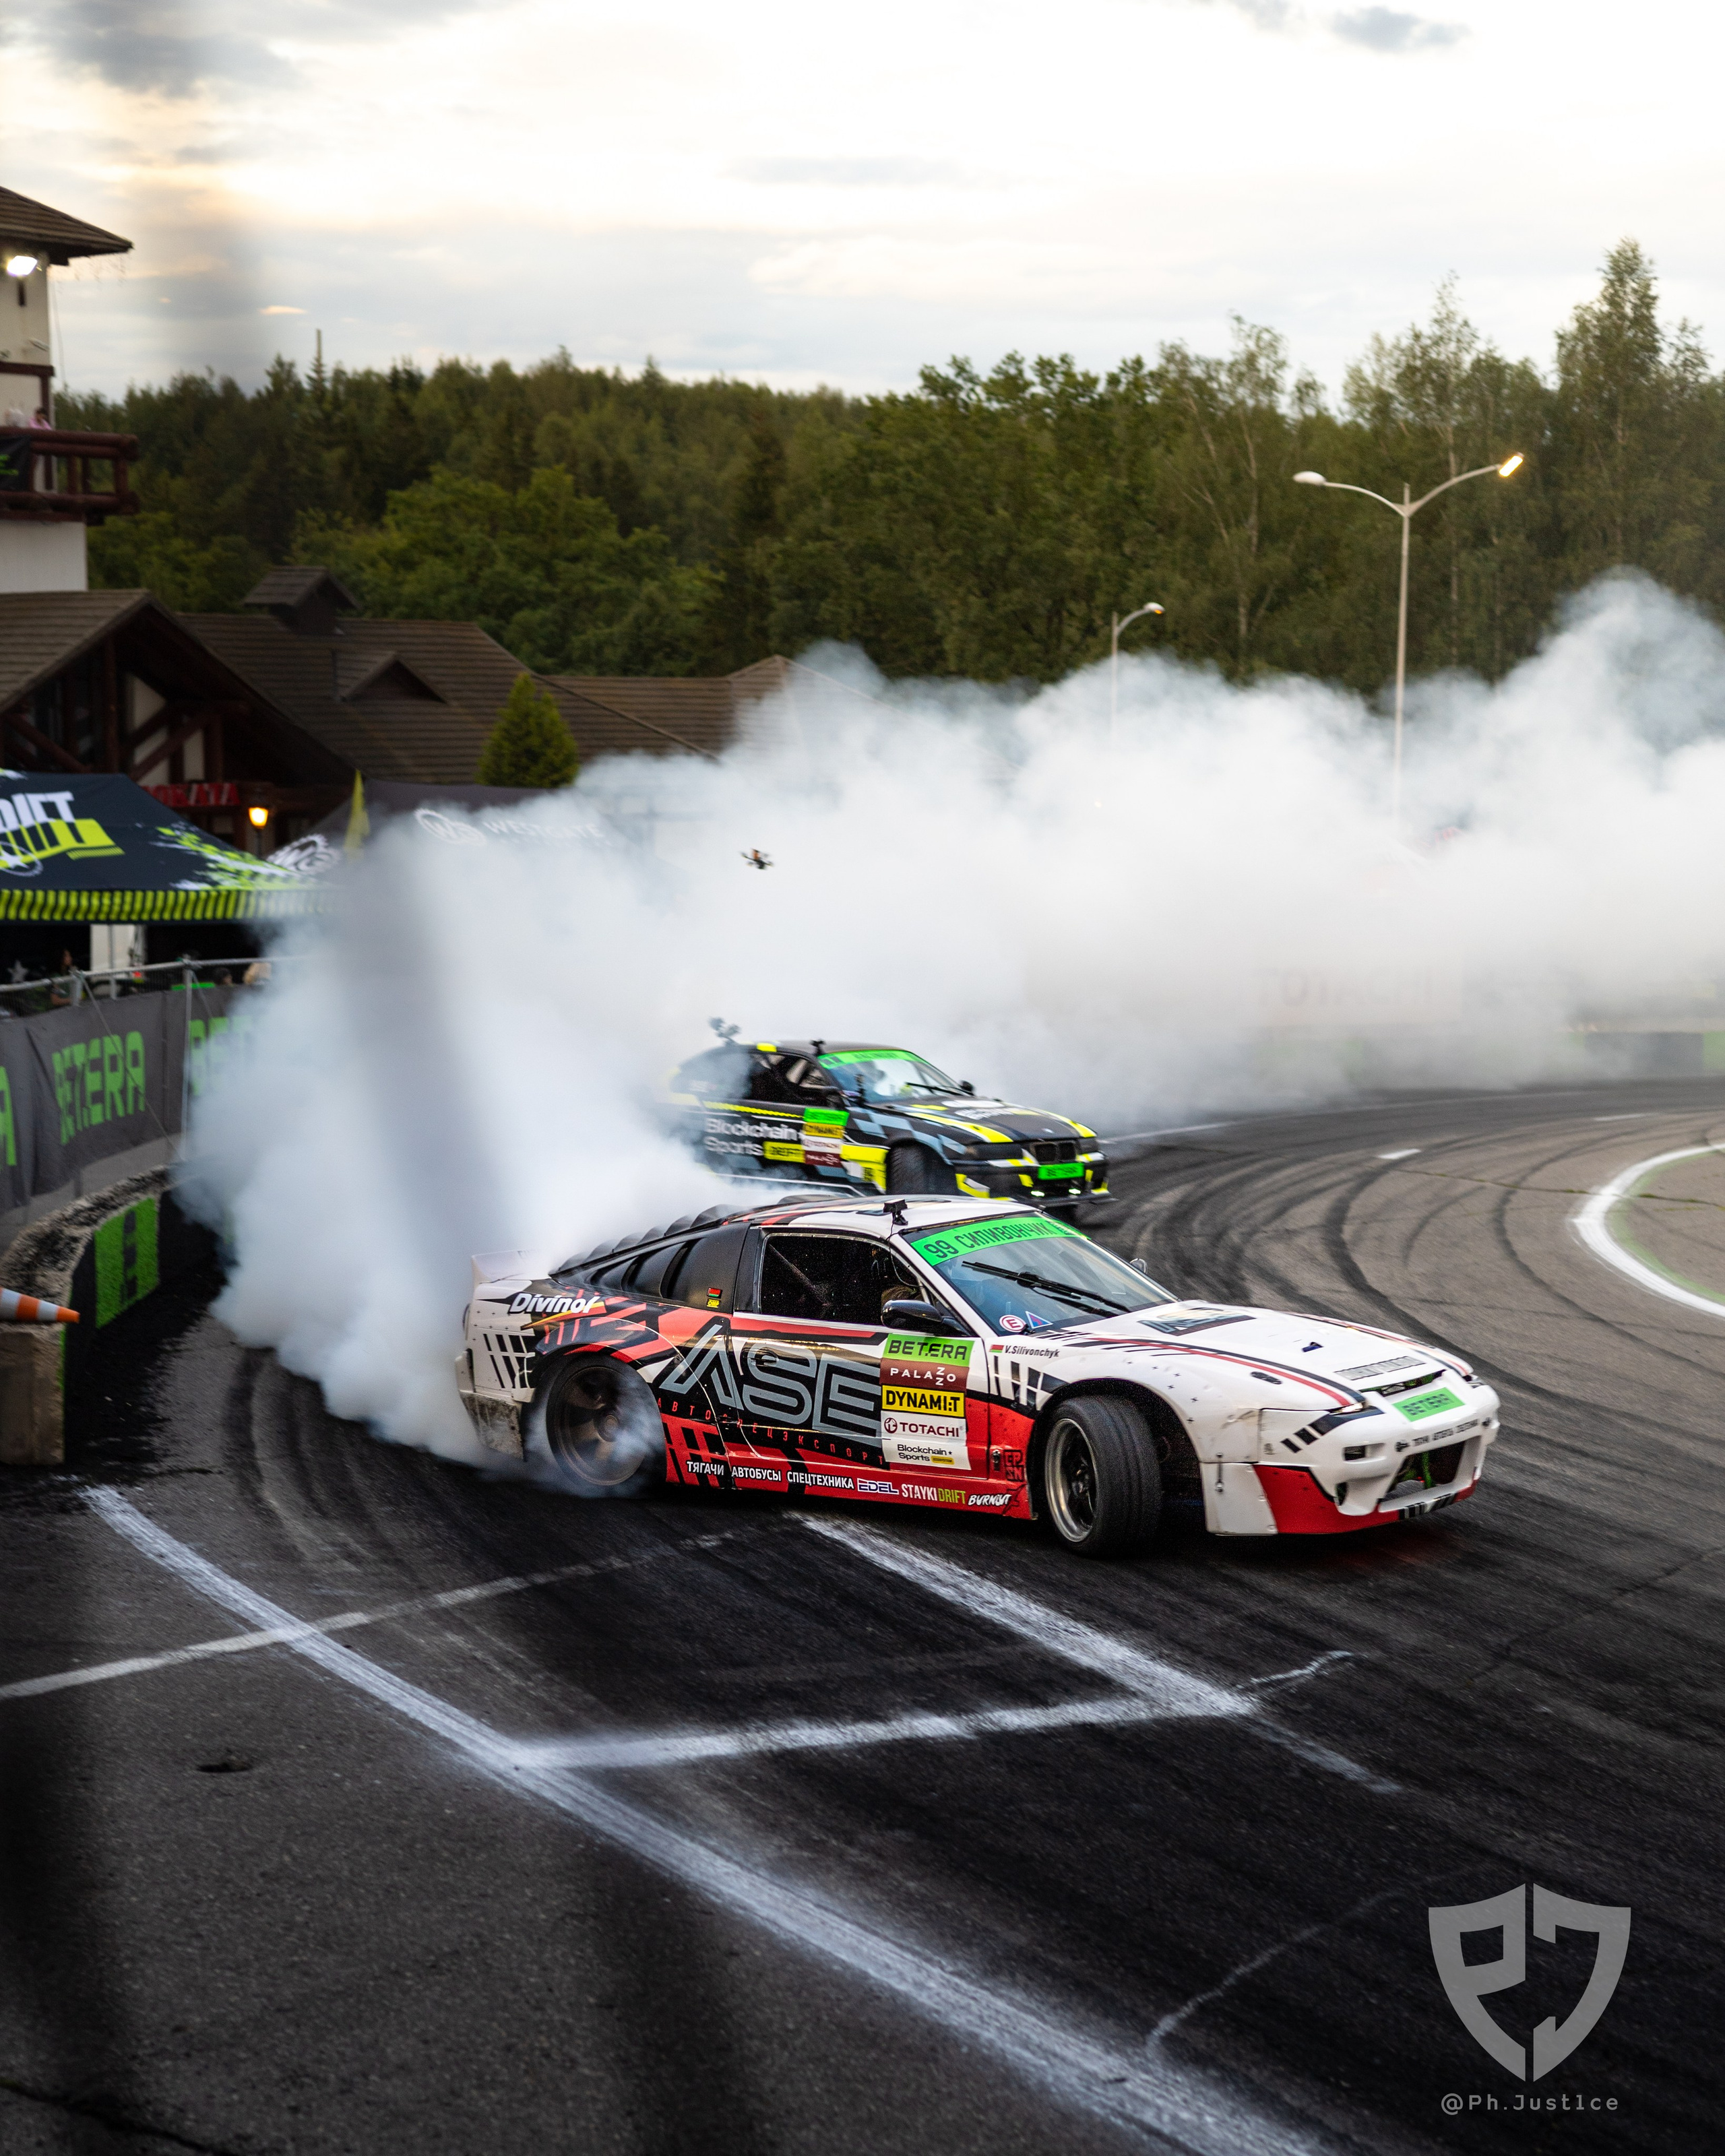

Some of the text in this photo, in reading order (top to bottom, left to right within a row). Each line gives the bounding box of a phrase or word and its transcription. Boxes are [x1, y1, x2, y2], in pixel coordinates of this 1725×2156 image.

[703, 1137, 764, 1156] Sports
[924, 1240, 960, 1259] 99
[509, 1293, 600, 1314] Divinol
[1005, 1345, 1060, 1358] V.Silivonchyk
[889, 1366, 956, 1386] PALAZZO
[658, 1324, 882, 1449] ASE
[900, 1422, 960, 1438] TOTACHI
[897, 1444, 947, 1456] Blockchain
[898, 1452, 931, 1461] Sports
[687, 1461, 854, 1490] ТЯГАЧИ АВТОБУСЫ СПЕЦТЕХНИКА
[857, 1479, 899, 1495] EDEL
